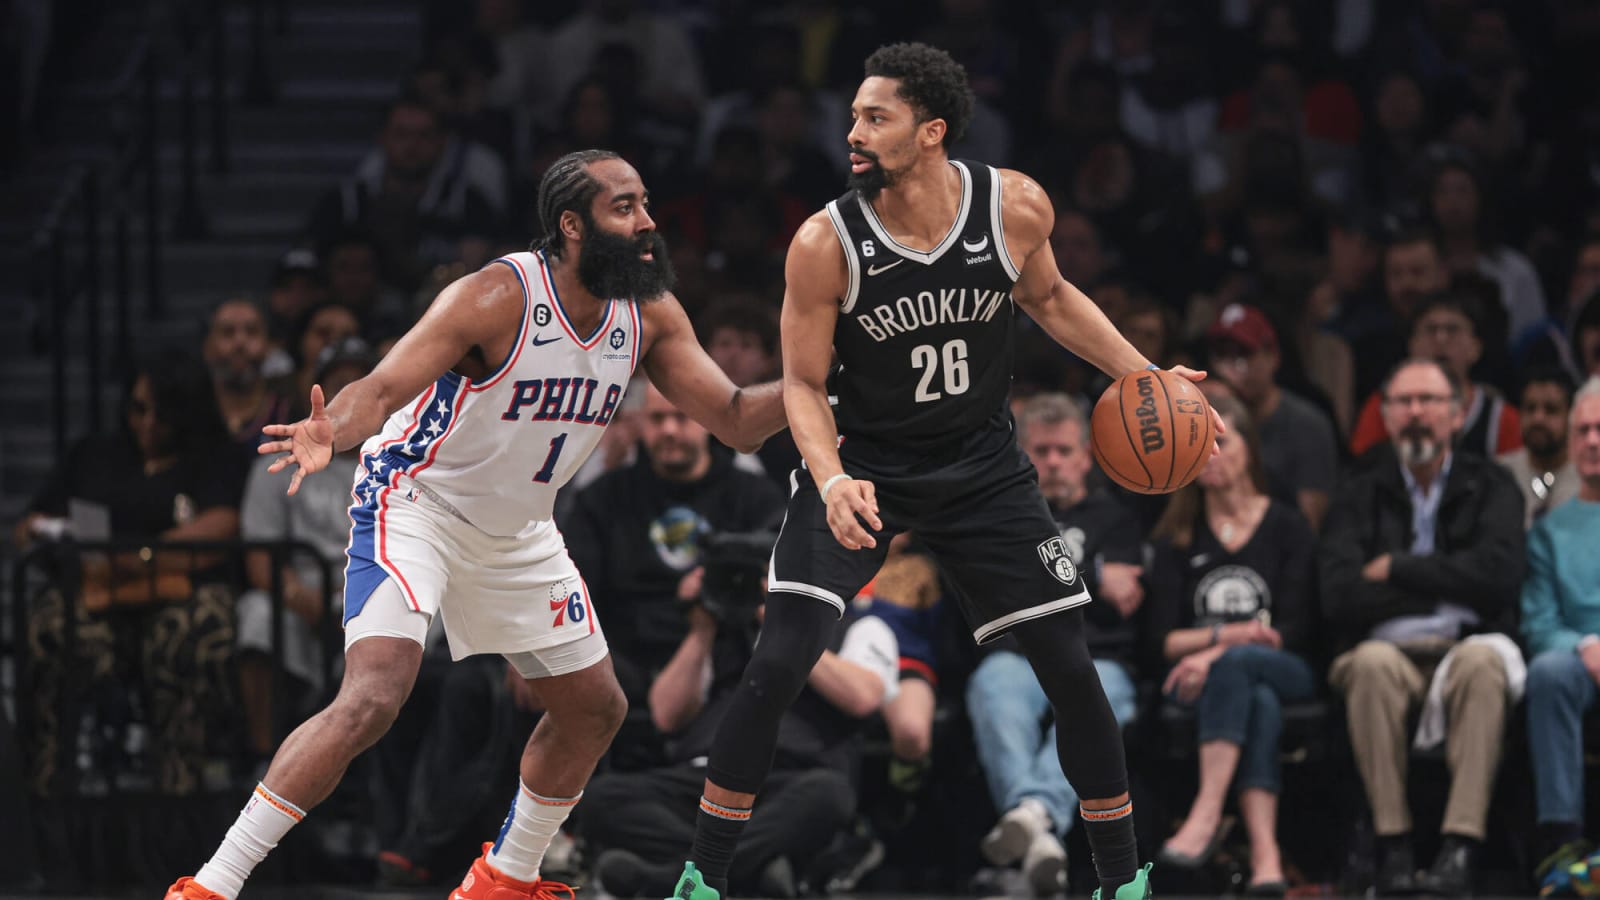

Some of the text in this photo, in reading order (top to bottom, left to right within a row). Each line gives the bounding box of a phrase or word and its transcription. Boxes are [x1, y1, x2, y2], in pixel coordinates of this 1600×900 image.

[861, 239, 876, 257] 6
[965, 253, 992, 265] Webull
[536, 306, 548, 324] 6
[857, 288, 1006, 342] BROOKLYN
[911, 338, 970, 403] 26
[501, 377, 621, 427] PHILA
[1136, 375, 1165, 455] Wilson
[532, 432, 568, 484] 1
[549, 591, 585, 628] 76
